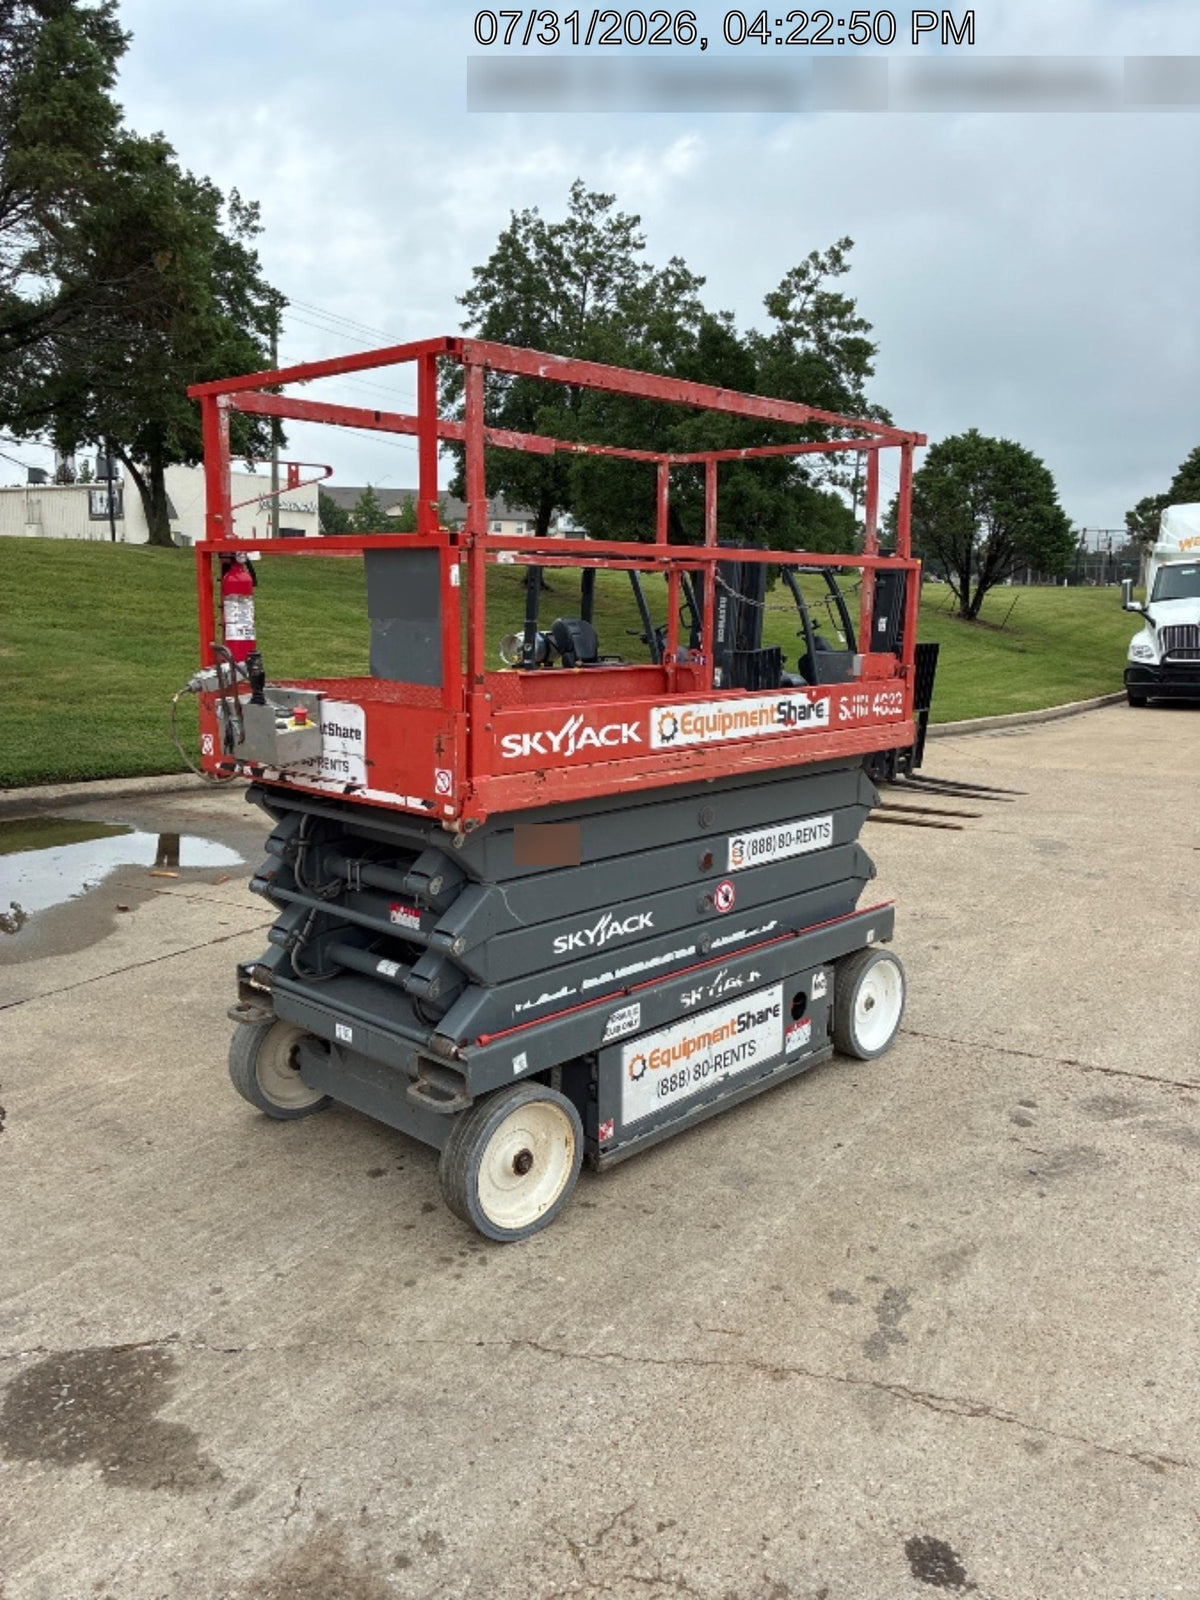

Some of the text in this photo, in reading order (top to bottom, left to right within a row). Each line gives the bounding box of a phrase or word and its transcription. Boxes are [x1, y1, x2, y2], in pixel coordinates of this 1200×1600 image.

[500, 713, 643, 758] SKYJACK
[680, 699, 824, 739] EquipmentShare
[747, 822, 831, 860] (888) 80-RENTS
[553, 911, 655, 954] SKYJACK
[648, 1003, 781, 1070] EquipmentShare
[656, 1039, 757, 1098] (888) 80-RENTS
